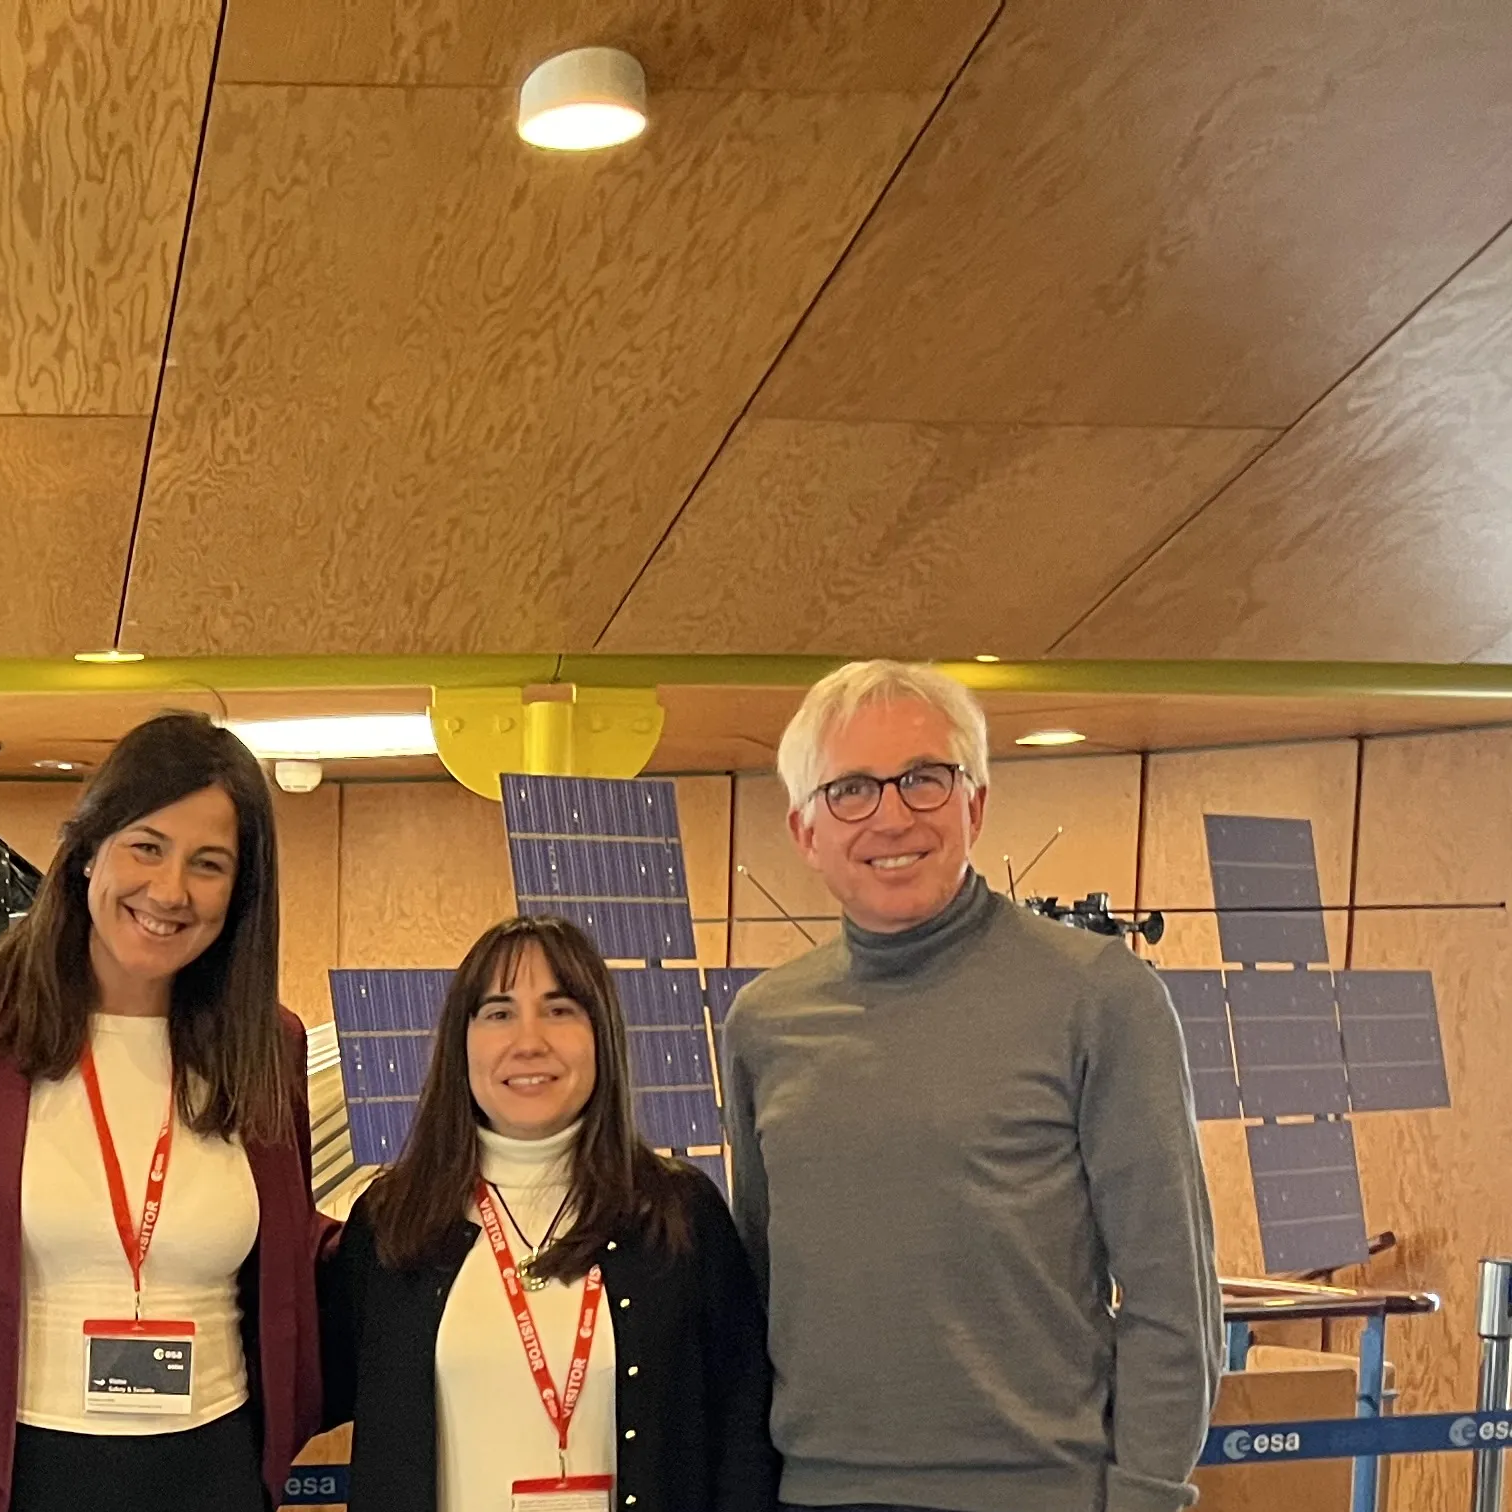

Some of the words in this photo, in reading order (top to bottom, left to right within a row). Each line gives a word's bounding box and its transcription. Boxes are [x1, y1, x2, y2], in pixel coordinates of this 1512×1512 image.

[138, 1200, 159, 1262] VISITOR
[480, 1197, 506, 1254] VISITOR
[517, 1310, 545, 1372] VISITOR
[563, 1358, 587, 1419] VISITOR
[1253, 1431, 1300, 1453] esa
[1479, 1421, 1512, 1440] es
[284, 1476, 336, 1496] esa
